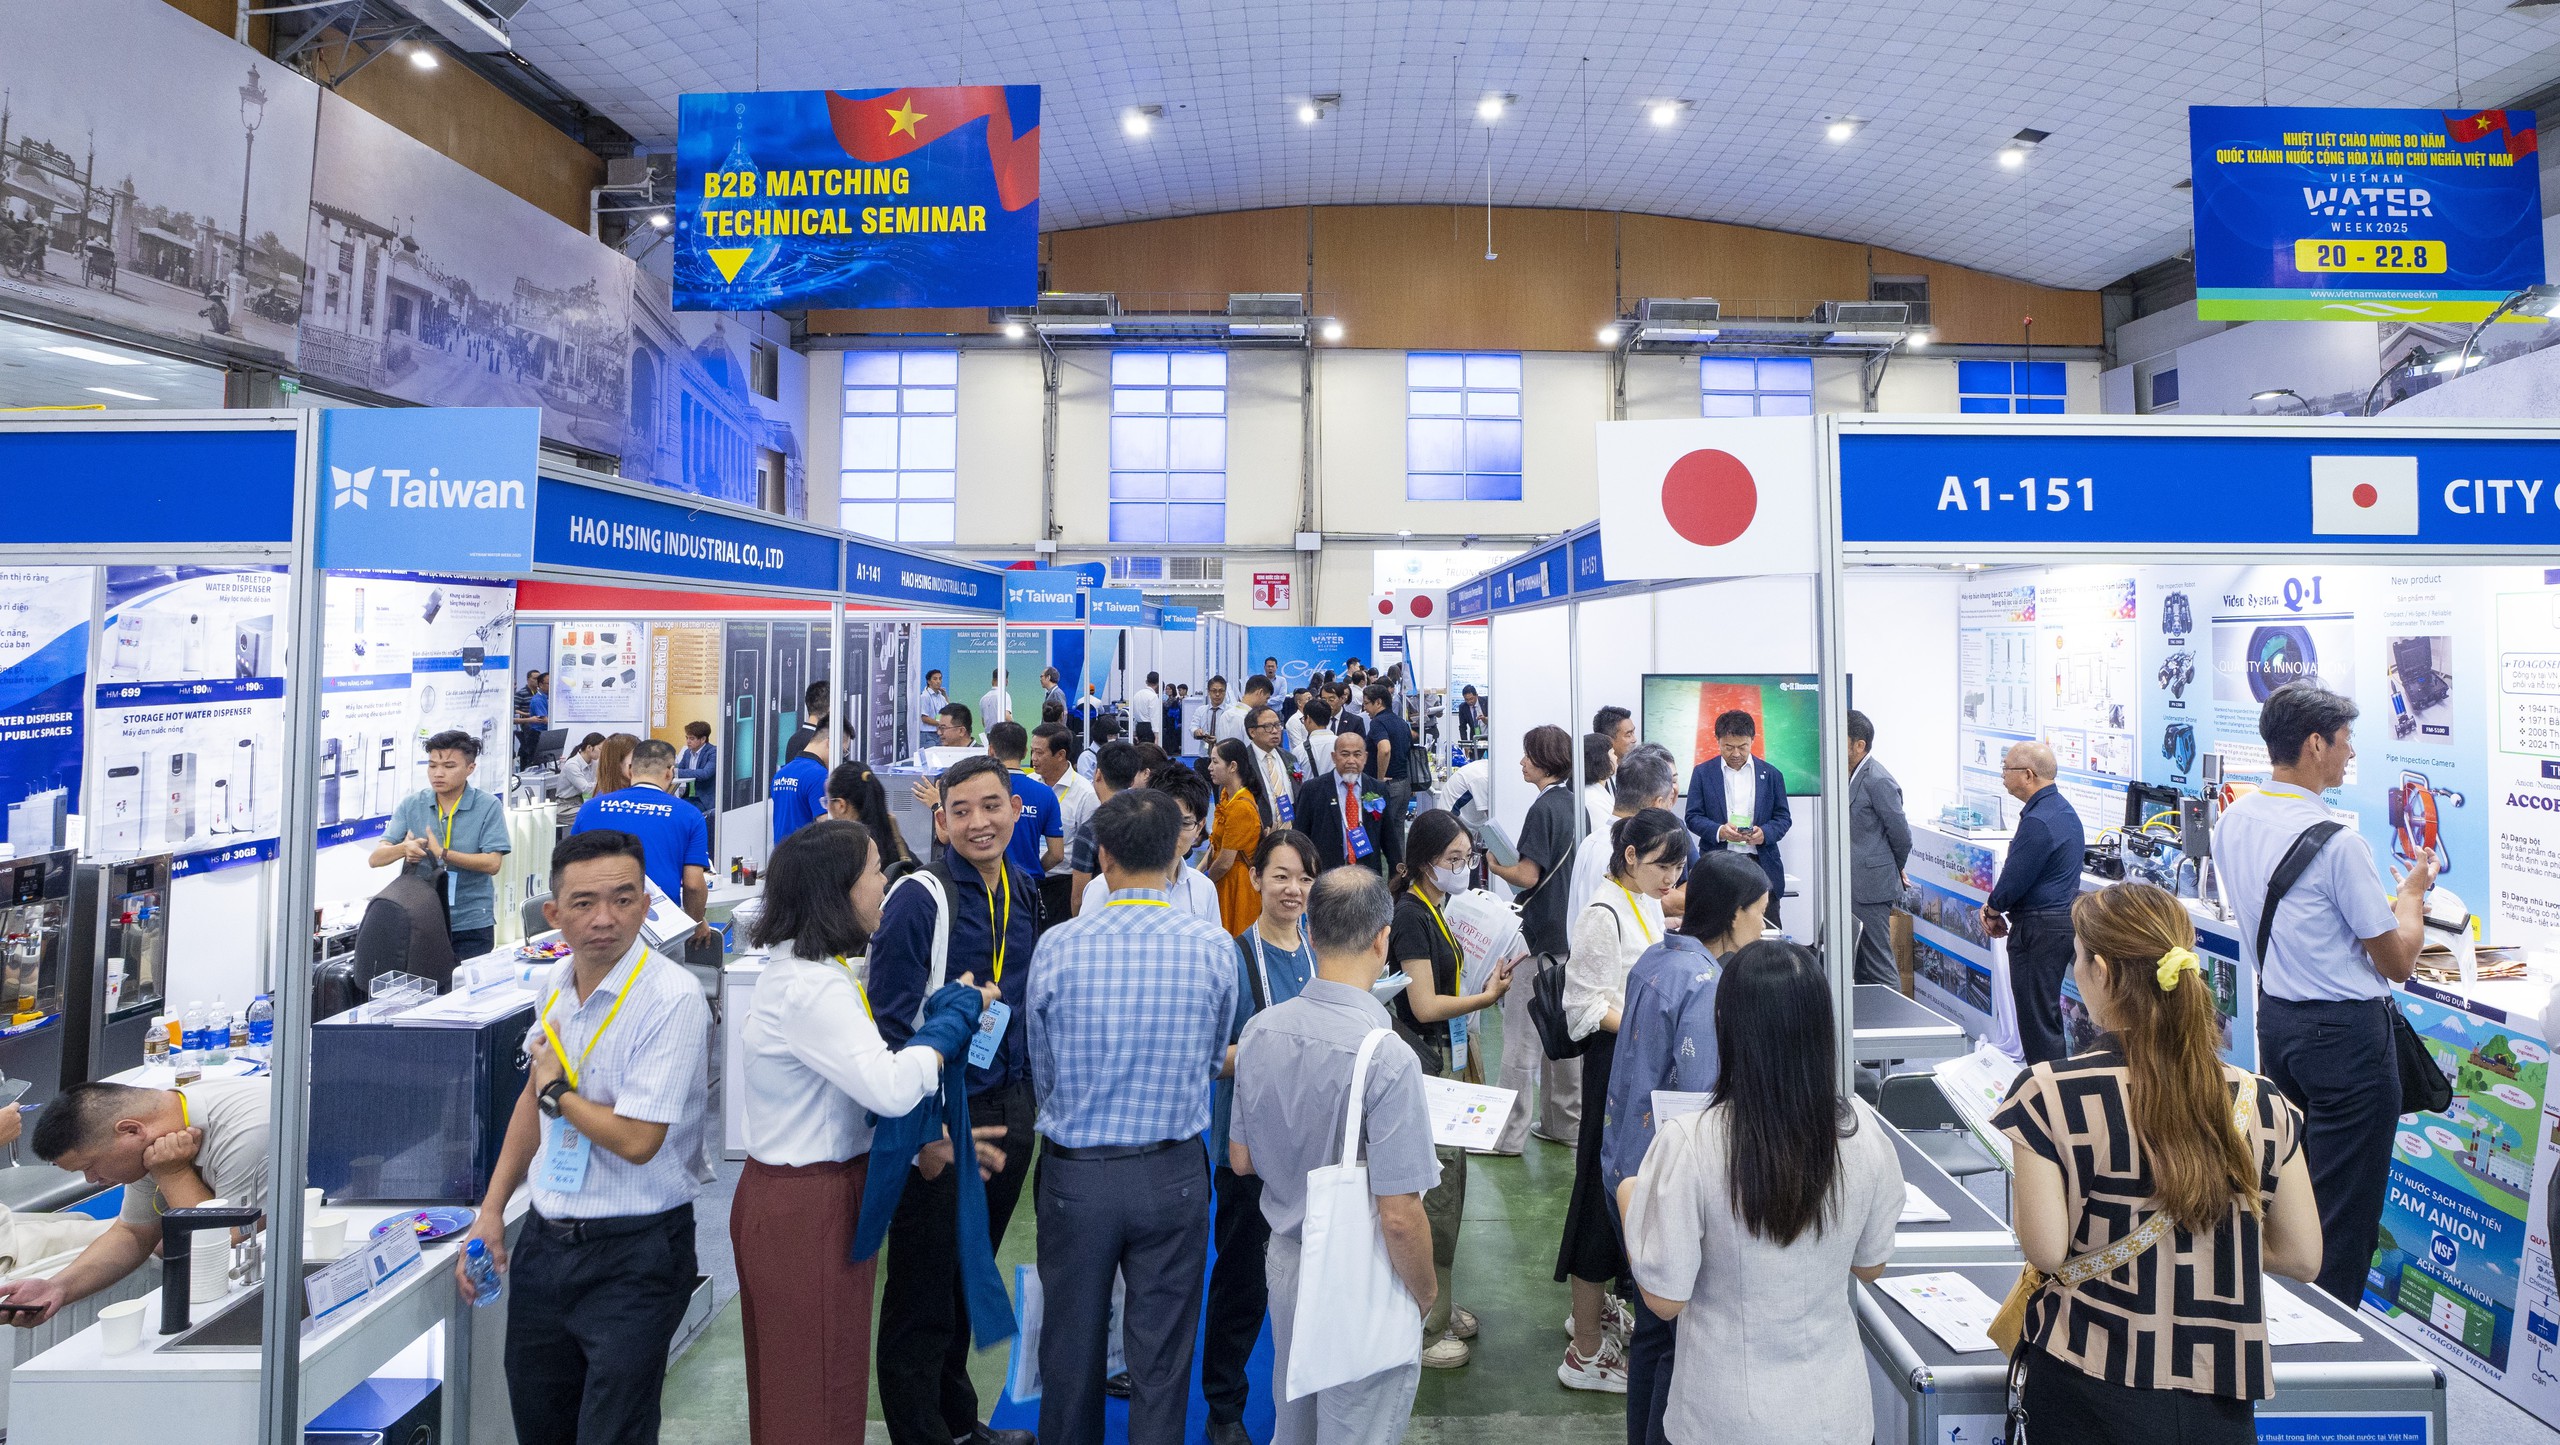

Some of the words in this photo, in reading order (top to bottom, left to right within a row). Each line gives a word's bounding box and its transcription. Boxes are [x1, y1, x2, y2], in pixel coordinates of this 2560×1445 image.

[2283, 132, 2311, 147] NHIỆT
[2315, 132, 2337, 148] LIỆT
[2339, 130, 2368, 147] CHÀO
[2369, 131, 2402, 147] MỪNG
[2404, 133, 2419, 148] 80
[2420, 133, 2446, 149] NĂM
[2216, 148, 2246, 165] QUỐC
[2247, 148, 2284, 165] KHÁNH
[2285, 148, 2314, 165] NƯỚC
[2316, 149, 2346, 168] CỘNG
[2347, 149, 2369, 166] HÒA
[2370, 149, 2385, 166] XÃ
[2386, 149, 2404, 167] HỘI
[2406, 149, 2428, 166] CHỦ
[2430, 150, 2463, 167] NGHĨA
[2464, 151, 2487, 169] VIỆT
[2488, 153, 2514, 168] NAM
[704, 172, 757, 199] B2B
[766, 167, 910, 197] MATCHING
[2330, 172, 2405, 184] VIETNAM
[2302, 186, 2434, 218] WATER
[702, 208, 853, 237] TECHNICAL
[861, 205, 987, 234] SEMINAR
[2317, 244, 2347, 268] 20
[2375, 245, 2428, 269] 22.8
[2310, 288, 2439, 300] www.vietnamwaterweek.vn
[382, 467, 526, 509] Taiwan
[1937, 475, 2095, 513] A1-151
[2443, 478, 2545, 515] CITY
[569, 515, 609, 547] HAO
[612, 522, 661, 554] HSING
[664, 531, 741, 565] INDUSTRIAL
[742, 544, 764, 570] CO.,
[765, 547, 784, 569] LTD
[237, 575, 272, 584] TABLETOP
[856, 563, 881, 582] A1-141
[901, 571, 914, 588] HAO
[914, 573, 932, 591] HSING
[931, 576, 961, 595] INDUSTRIAL
[968, 583, 978, 597] LTD
[2391, 576, 2409, 586] New
[2411, 573, 2442, 587] product
[205, 583, 231, 592] WATER
[231, 584, 272, 593] DISPENSER
[1026, 589, 1074, 604] Taiwan
[2223, 595, 2245, 607] Video
[2248, 594, 2279, 608] System
[1104, 601, 1140, 613] Taiwan
[2383, 610, 2404, 618] Compact
[2432, 609, 2452, 617] Reliable
[1172, 615, 1196, 623] Taiwan
[1311, 636, 1344, 644] WATER
[2263, 661, 2271, 673] &
[106, 687, 142, 699] HM-699
[123, 713, 164, 724] STORAGE
[165, 711, 183, 722] HOT
[184, 709, 212, 721] WATER
[213, 707, 252, 718] DISPENSER
[2528, 704, 2547, 713] 1944
[26, 711, 73, 725] DISPENSER
[2528, 716, 2547, 725] 1971
[4, 728, 40, 742] PUBLIC
[40, 726, 73, 739] SPACES
[2528, 728, 2547, 737] 2008
[2528, 739, 2547, 749] 2024
[2386, 754, 2401, 765] Pipe
[2402, 755, 2433, 768] Inspection
[2434, 758, 2456, 769] Camera
[2183, 786, 2199, 795] Nuclear
[331, 828, 354, 839] HM-900
[2510, 834, 2527, 845] Dạng
[2510, 893, 2528, 904] Dạng
[1458, 921, 1475, 936] TOP
[2435, 991, 2451, 1004] ỨNG
[2500, 1093, 2526, 1107] Manufacture
[2394, 1169, 2404, 1182] LÝ
[2404, 1177, 2431, 1197] NƯỚC
[2431, 1189, 2457, 1210] SẠCH
[2457, 1201, 2480, 1219] TIÊN
[2480, 1210, 2502, 1233] TIẾN
[2390, 1187, 2426, 1219] PAM
[2427, 1207, 2487, 1250] ANION
[2530, 1234, 2547, 1248] QUY
[2433, 1239, 2454, 1262] NSF
[2416, 1257, 2436, 1274] ACH
[2442, 1270, 2462, 1288] PAM
[2462, 1281, 2494, 1308] ANION
[2426, 1329, 2463, 1358] TOAGOSEI
[2465, 1354, 2503, 1381] VIETNAM
[2285, 1434, 2305, 1442] trong
[2336, 1433, 2356, 1441] thoát
[2356, 1433, 2377, 1441] nước
[2387, 1433, 2402, 1442] Việt
